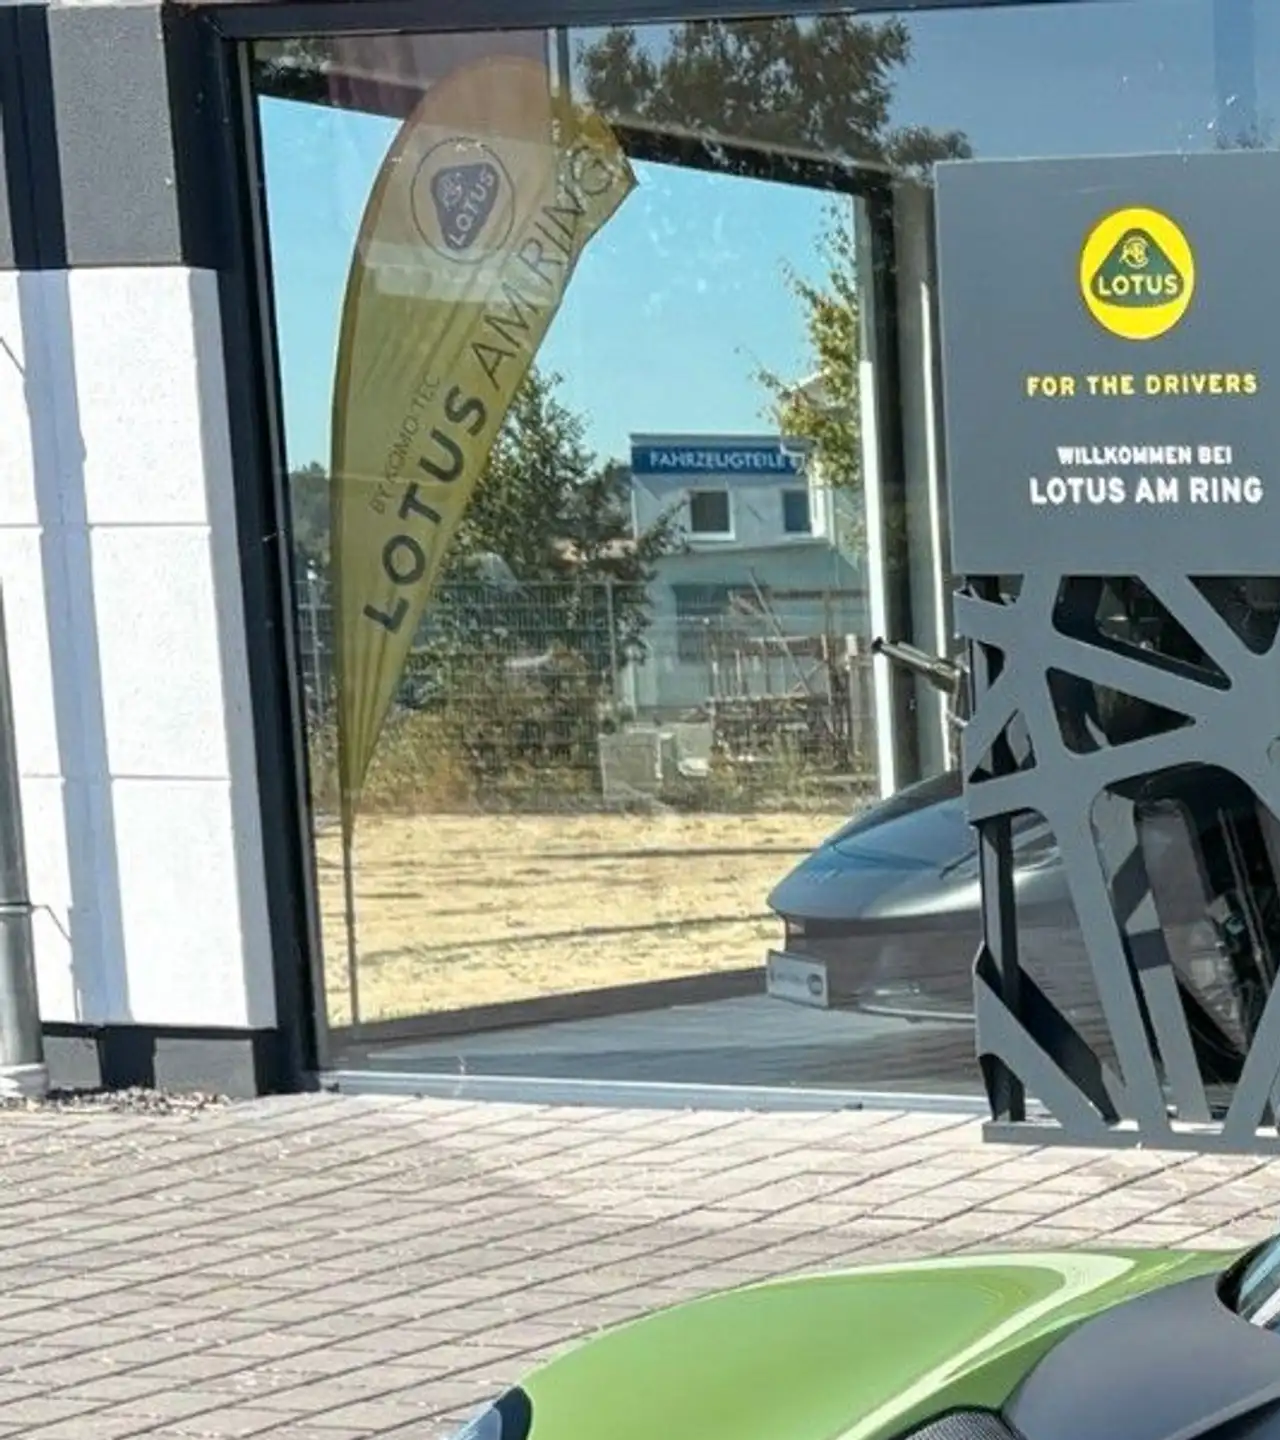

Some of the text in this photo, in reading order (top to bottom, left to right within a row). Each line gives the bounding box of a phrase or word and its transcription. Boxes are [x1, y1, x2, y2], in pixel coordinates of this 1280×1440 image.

[449, 166, 495, 246] LOTUS
[1098, 274, 1178, 297] LOTUS
[1026, 372, 1258, 397] FOR THE DRIVERS
[363, 385, 487, 634] LOTUS
[471, 281, 542, 392] AM
[1056, 445, 1233, 466] WILLKOMMEN BEI
[1029, 476, 1265, 505] LOTUS AM RING
